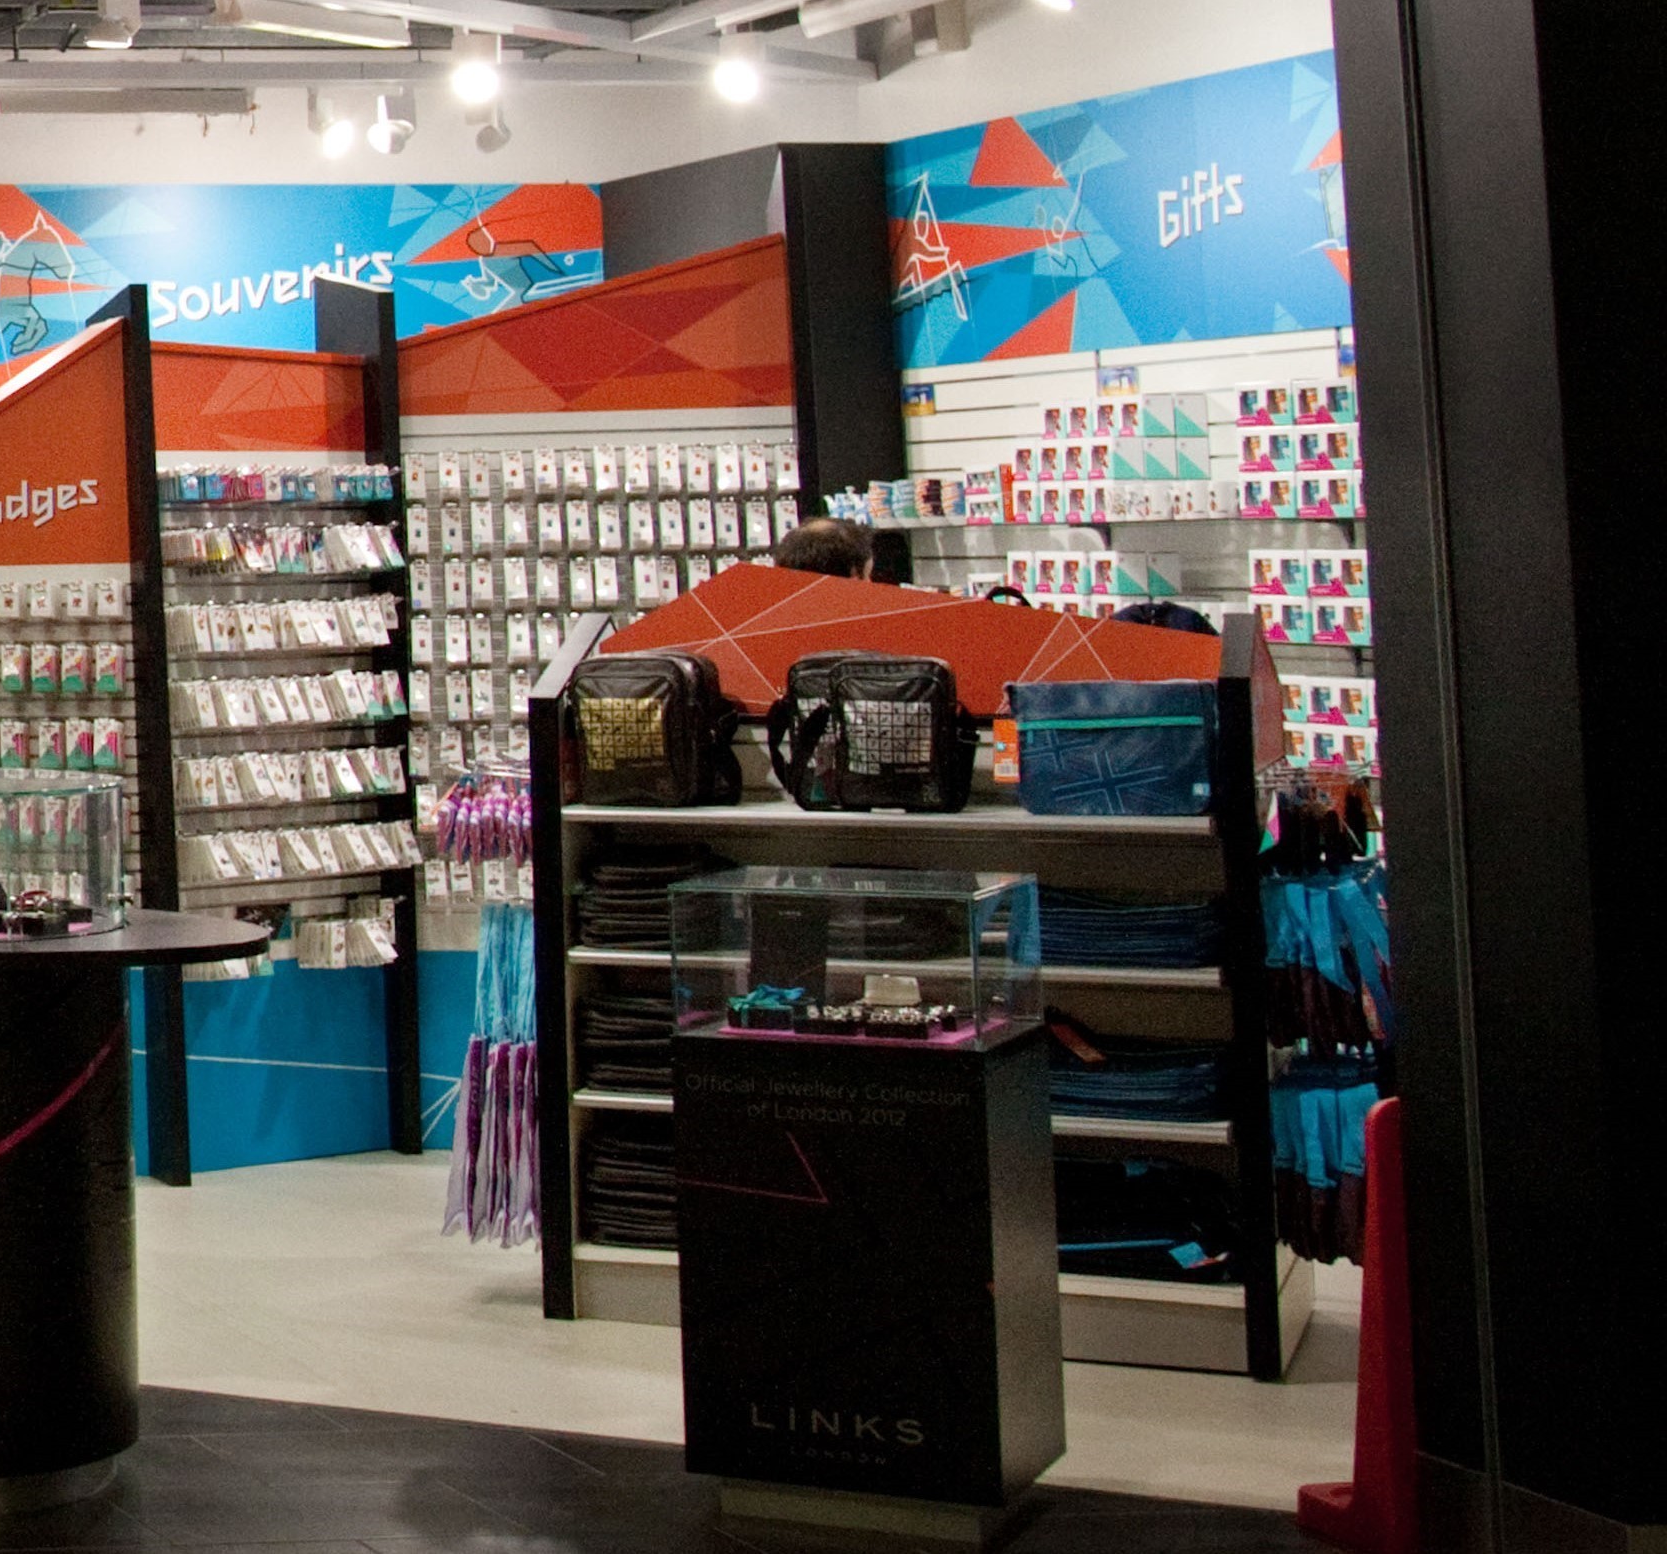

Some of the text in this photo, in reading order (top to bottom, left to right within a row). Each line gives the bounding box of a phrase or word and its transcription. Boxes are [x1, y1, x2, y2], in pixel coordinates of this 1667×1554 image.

[1157, 162, 1246, 248] Gifts
[685, 1073, 971, 1107] Official Jewellery Collection
[747, 1100, 908, 1128] of London 2012
[749, 1401, 926, 1447] LINKS
